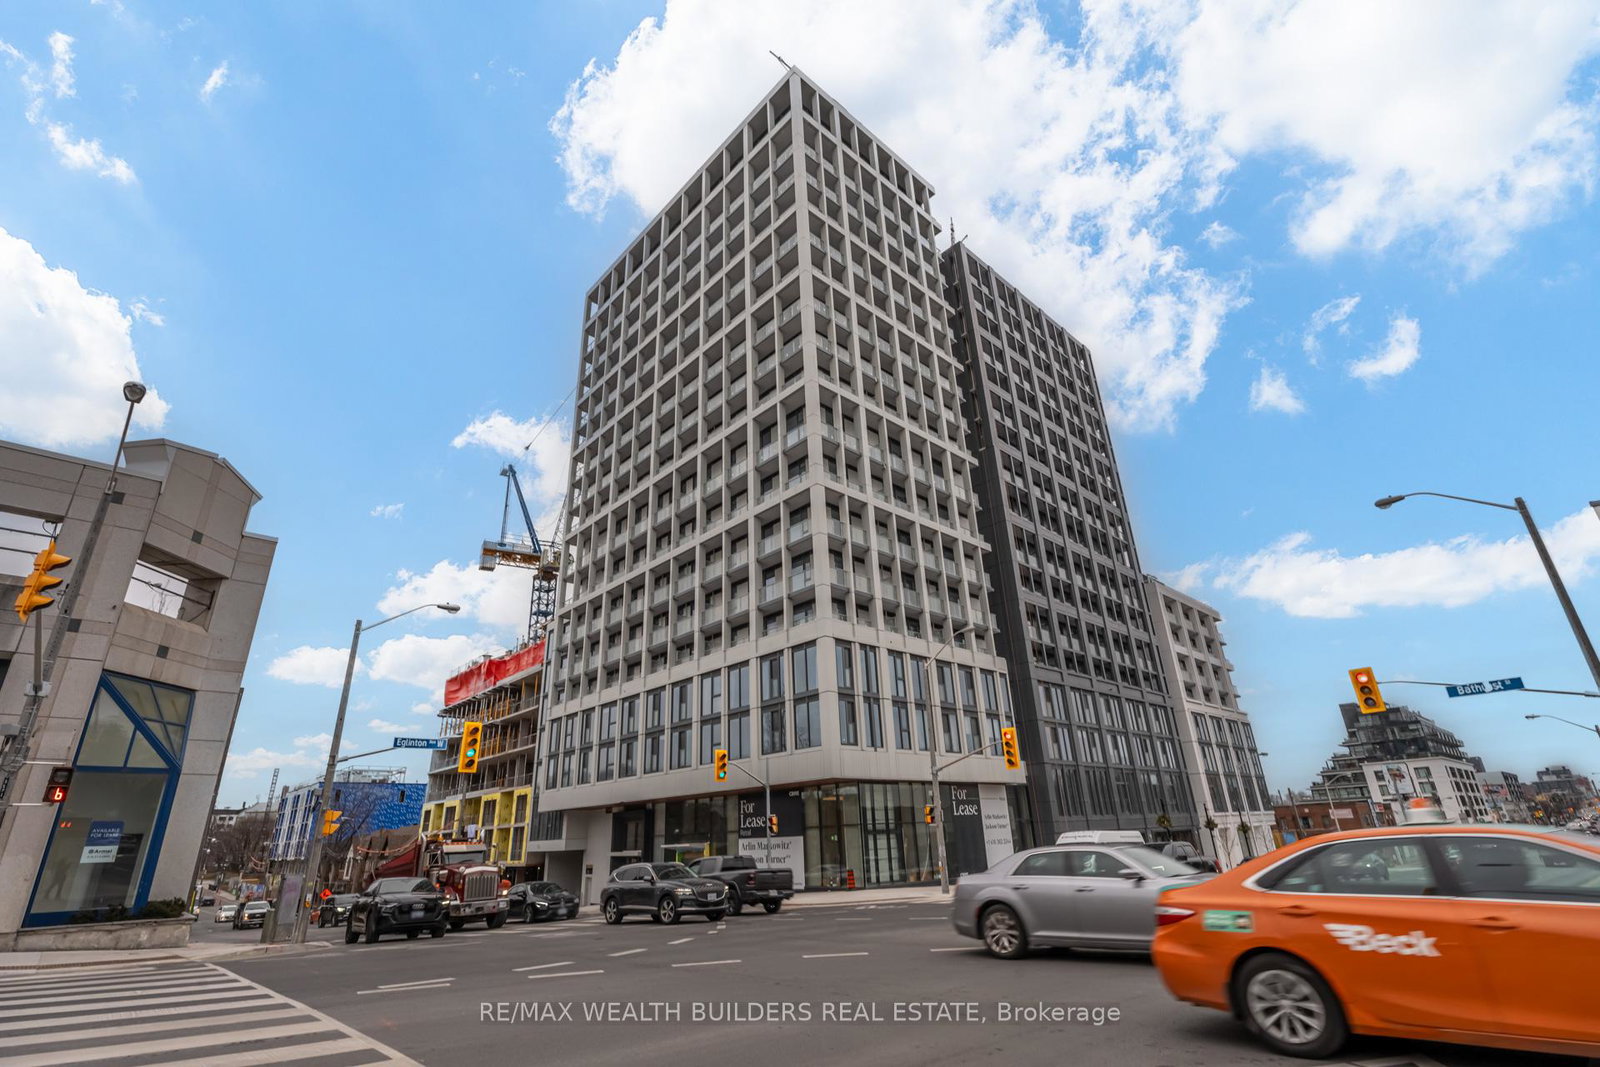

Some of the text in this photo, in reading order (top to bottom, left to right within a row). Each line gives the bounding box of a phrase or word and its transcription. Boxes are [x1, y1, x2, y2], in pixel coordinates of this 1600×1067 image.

[1457, 681, 1504, 695] Bathust
[397, 738, 427, 748] Eglinton
[951, 785, 967, 800] For
[740, 800, 755, 814] For
[952, 800, 978, 816] Lease
[740, 815, 766, 828] Lease
[742, 842, 756, 851] Arlin
[1324, 923, 1442, 957] Beck
